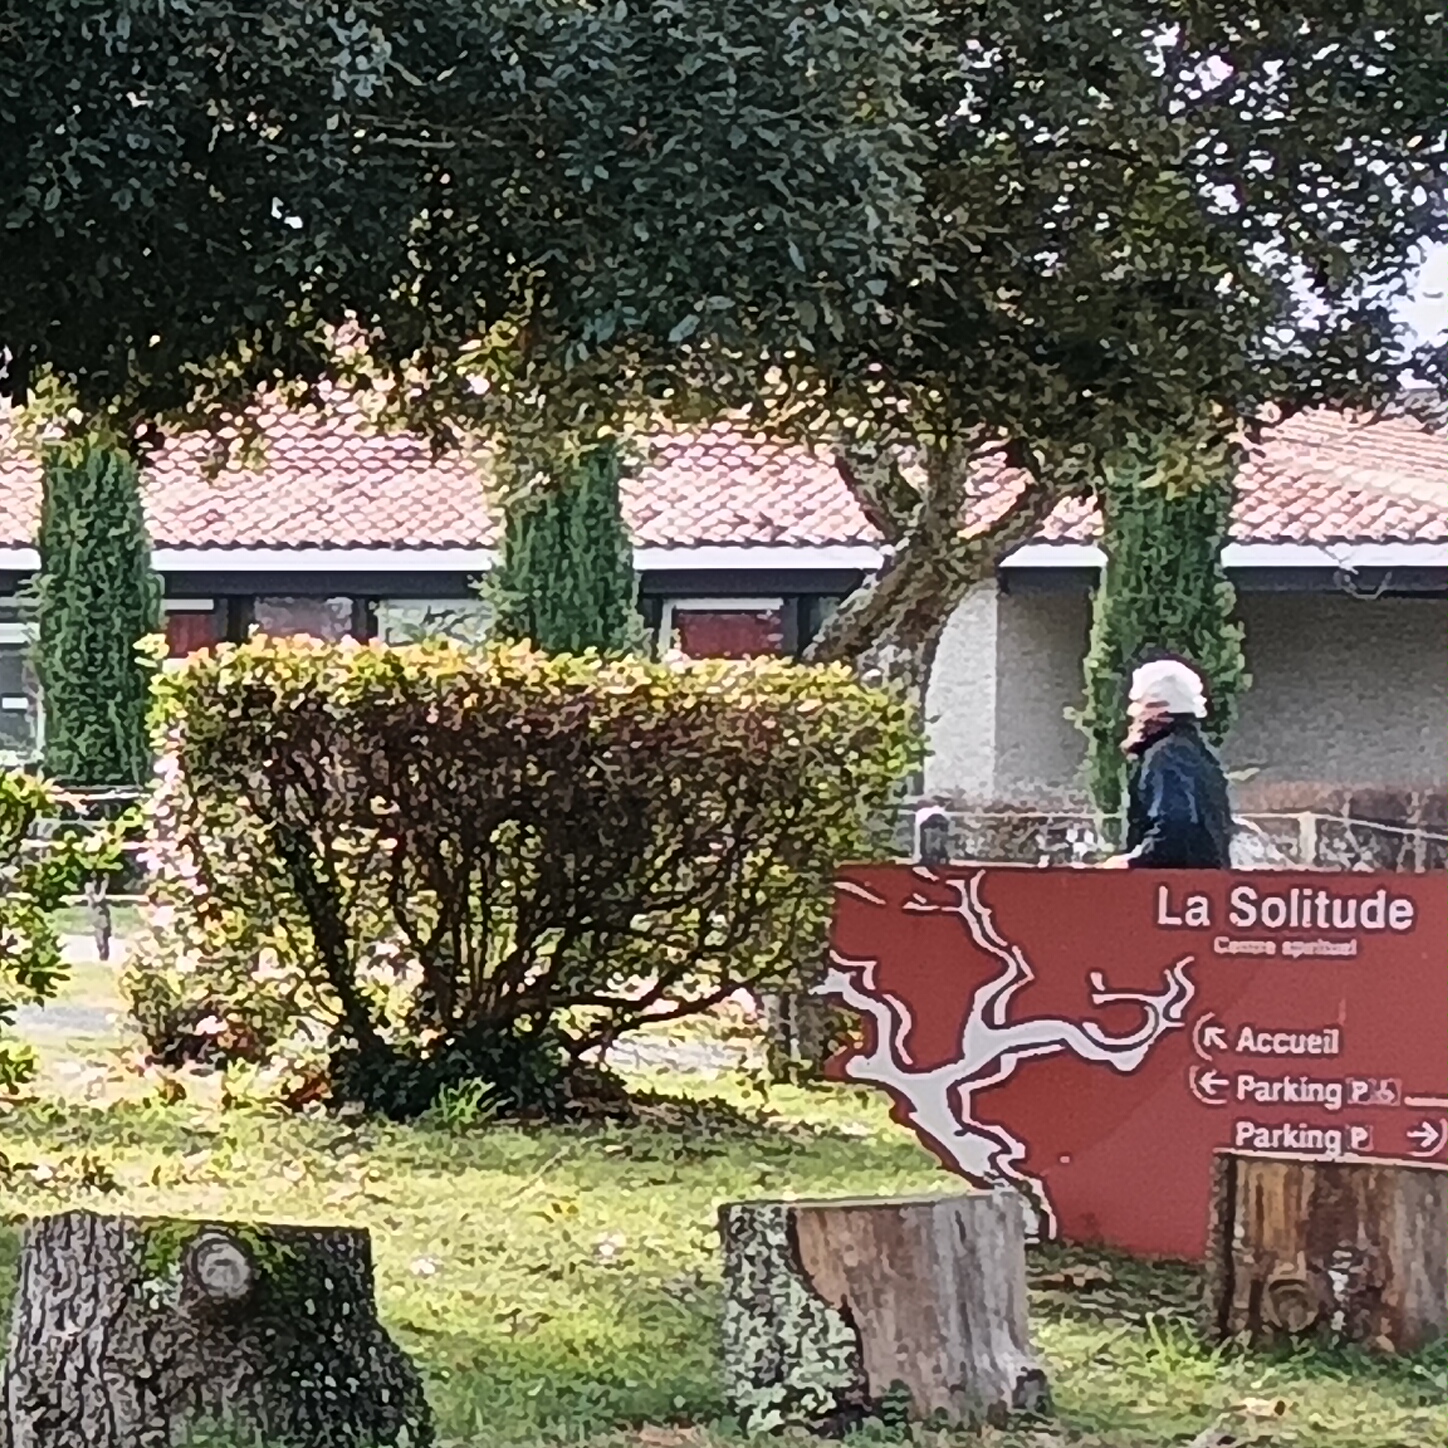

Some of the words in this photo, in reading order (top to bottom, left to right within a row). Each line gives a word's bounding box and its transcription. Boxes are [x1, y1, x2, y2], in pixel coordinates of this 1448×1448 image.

[1157, 885, 1211, 927] La
[1229, 885, 1415, 930] Solitude
[1235, 1026, 1340, 1054] Accueil
[1236, 1074, 1342, 1109] Parking
[1235, 1121, 1342, 1156] Parking
